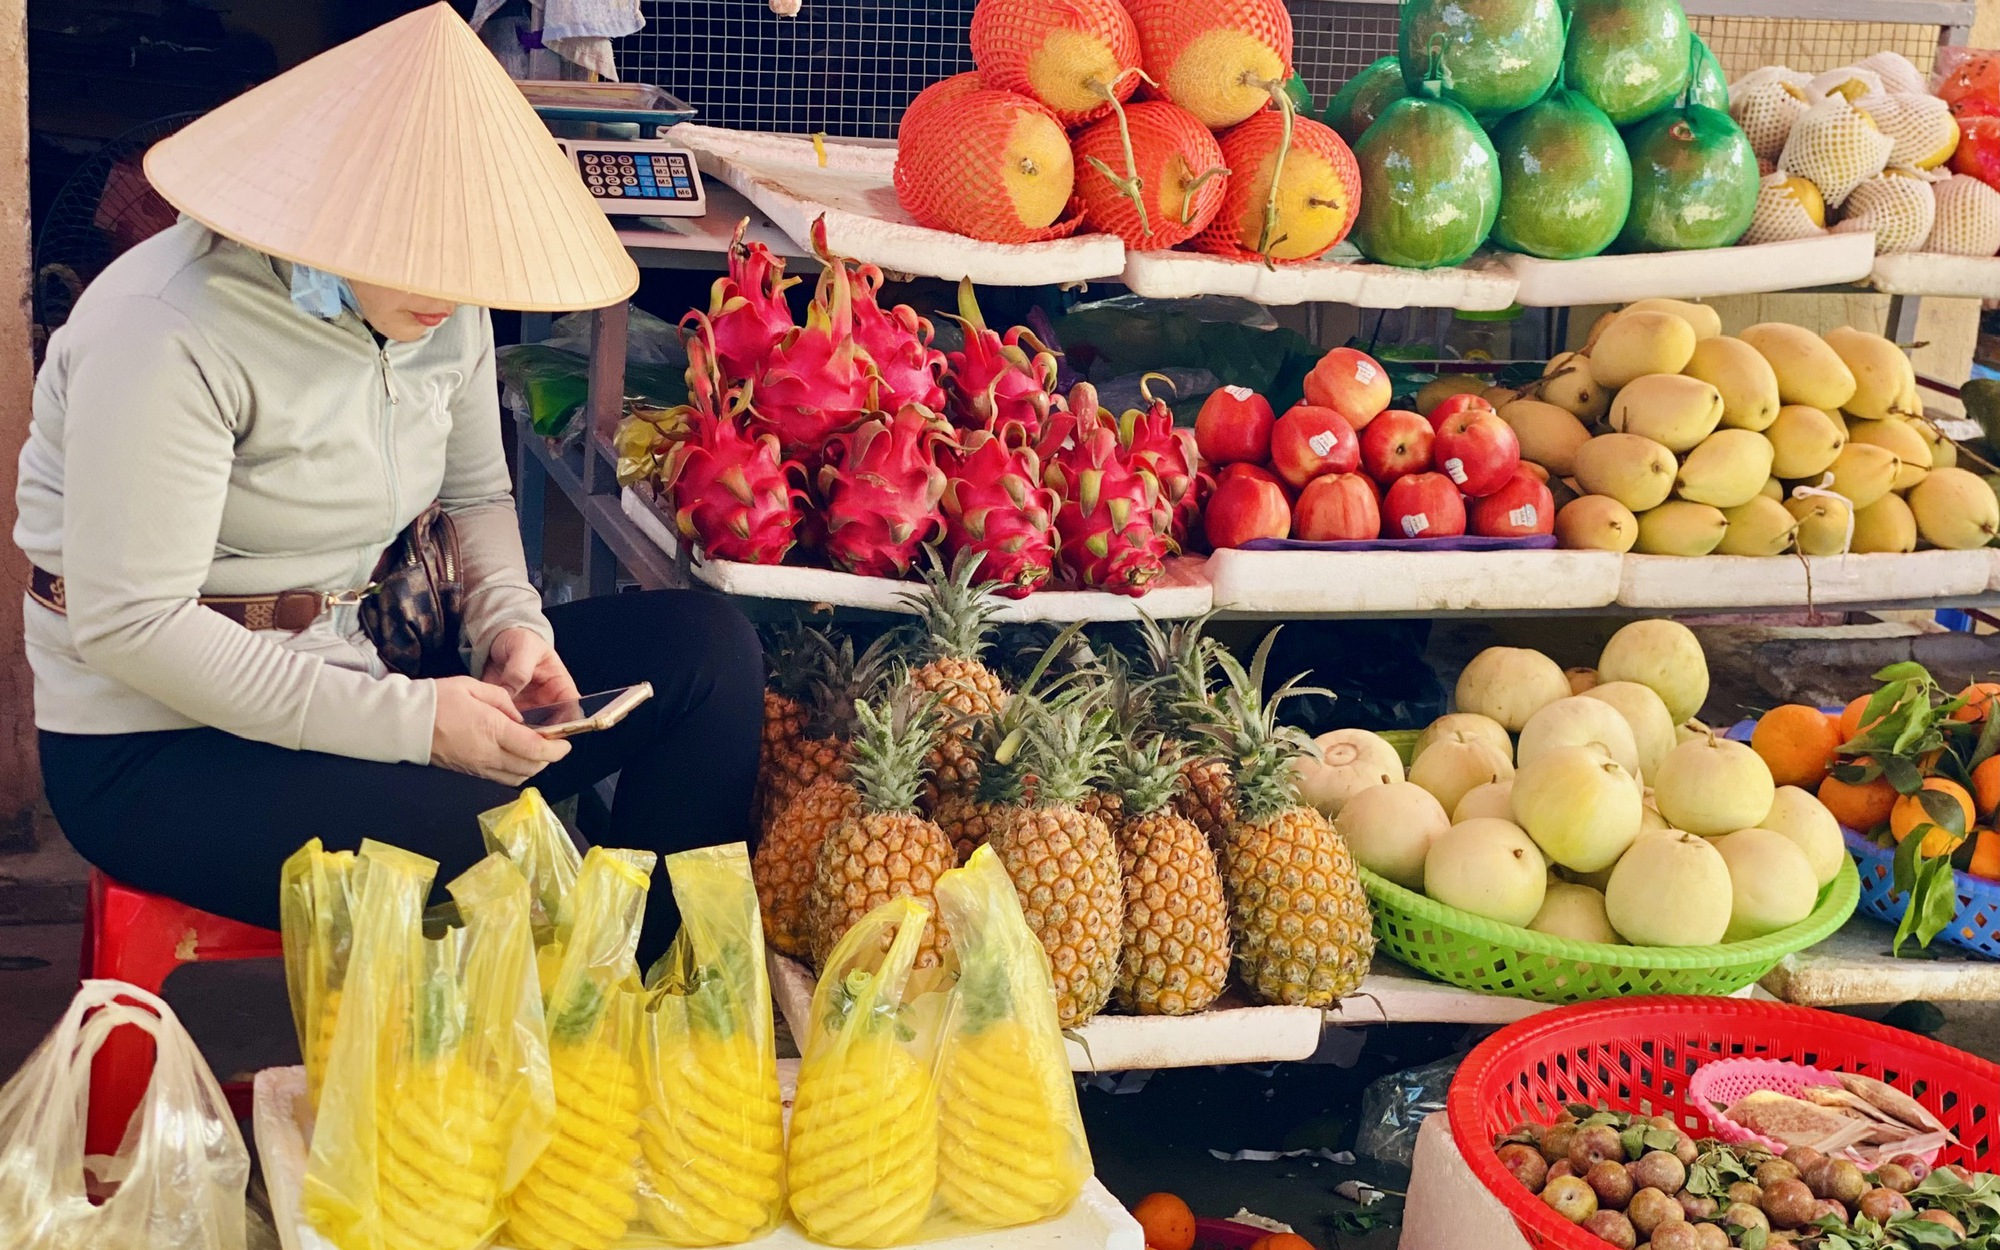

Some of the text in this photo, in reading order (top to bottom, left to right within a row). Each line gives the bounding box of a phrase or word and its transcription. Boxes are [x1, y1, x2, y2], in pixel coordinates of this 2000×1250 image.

[605, 166, 615, 174] 5
[623, 166, 633, 174] 6
[625, 177, 635, 185] 3
